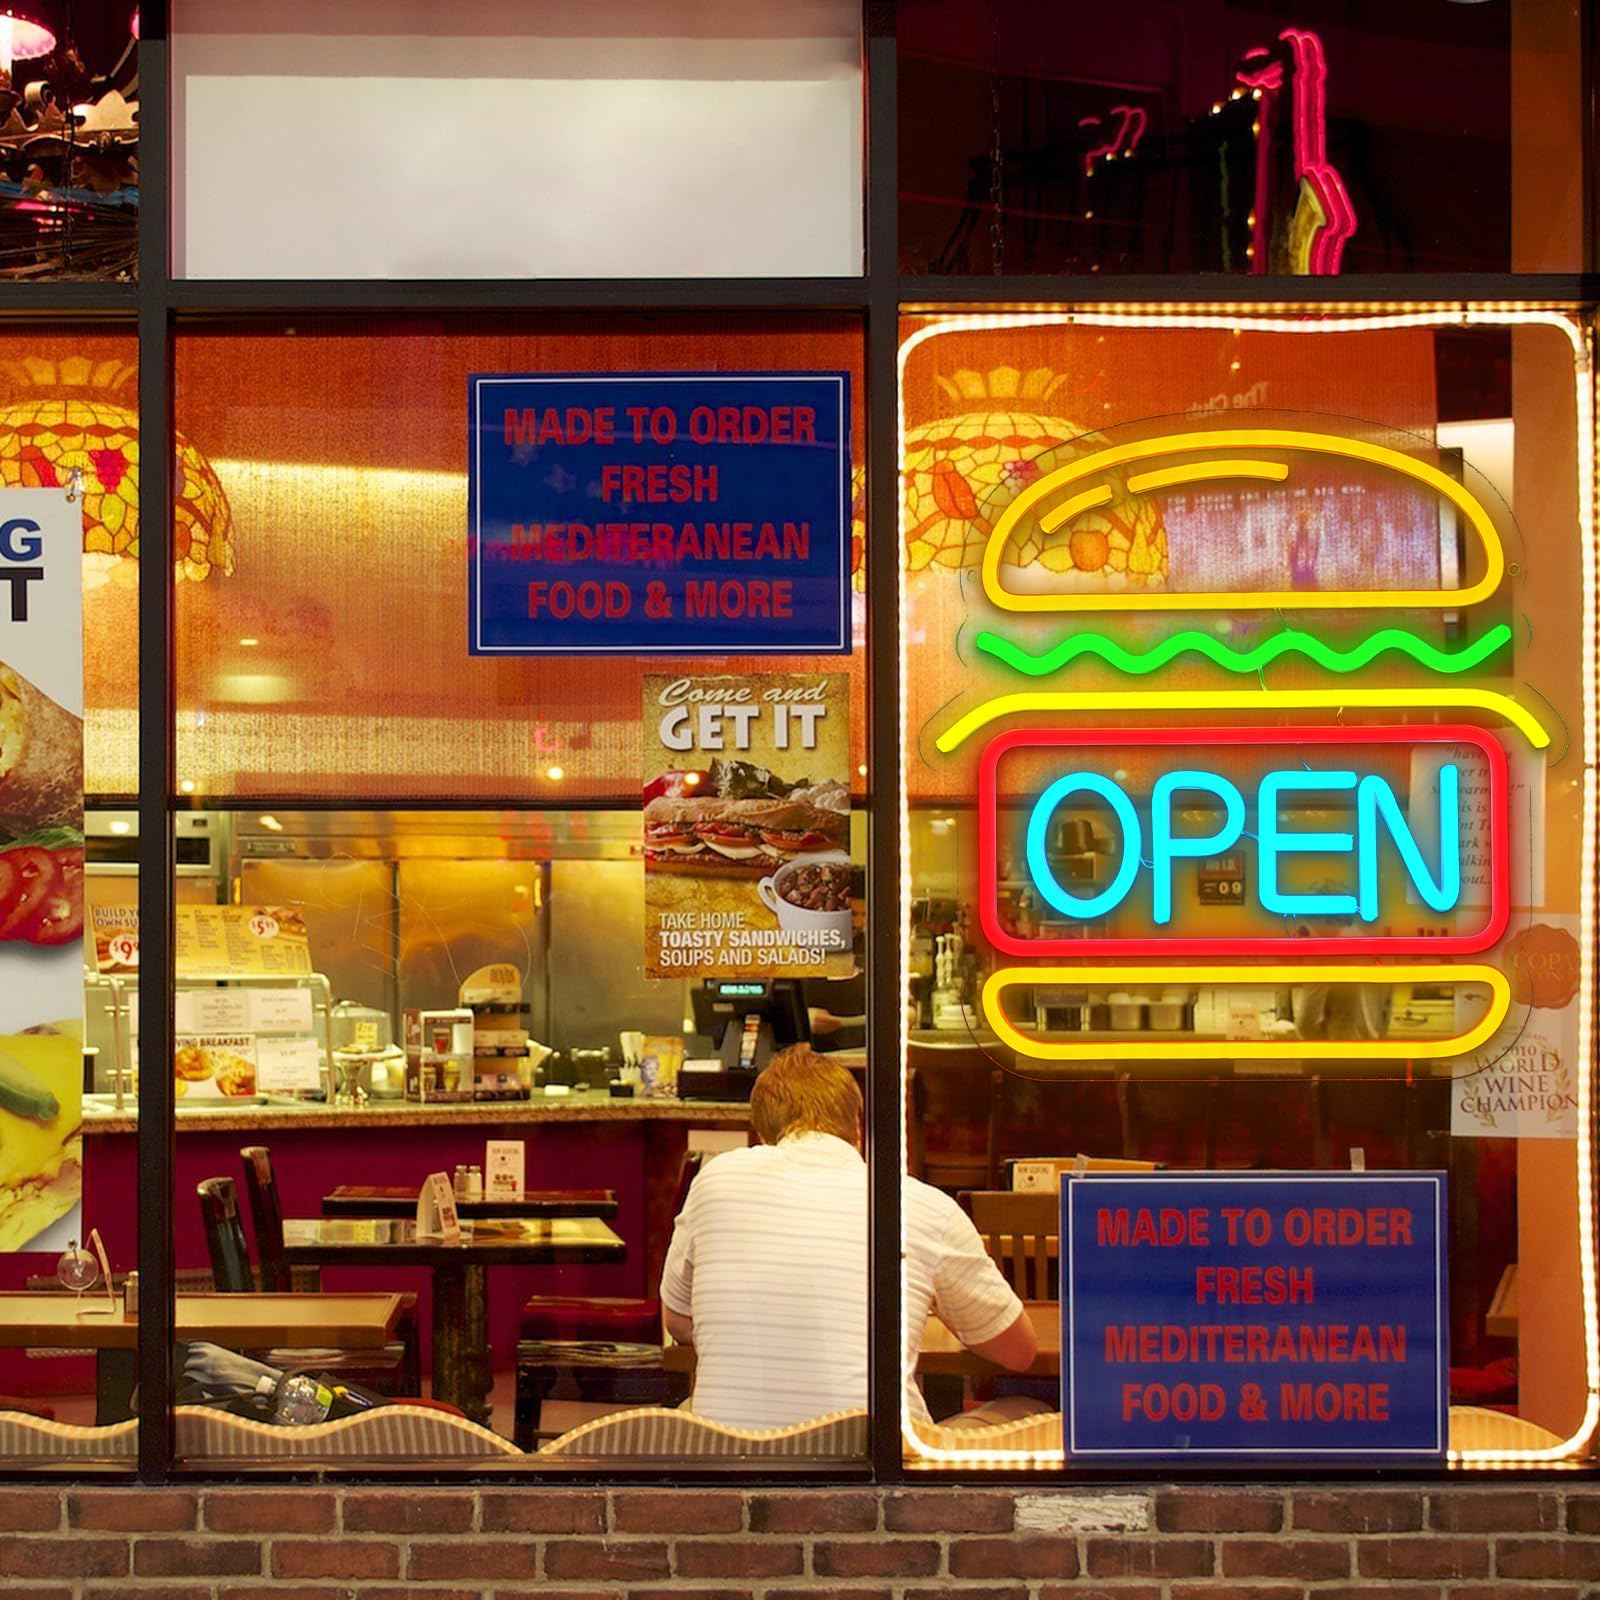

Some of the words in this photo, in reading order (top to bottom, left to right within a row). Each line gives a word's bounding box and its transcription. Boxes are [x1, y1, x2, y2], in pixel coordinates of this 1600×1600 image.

[504, 406, 615, 446] MADE
[626, 406, 677, 445] TO
[689, 406, 816, 446] ORDER
[601, 464, 718, 503] FRESH
[510, 522, 809, 561] MEDITERANEAN
[528, 580, 632, 619] FOOD
[643, 580, 673, 619] &
[685, 580, 793, 619] MORE
[658, 678, 752, 707] Come
[763, 679, 828, 703] and
[659, 704, 759, 751] GET
[775, 704, 826, 749] IT
[1026, 764, 1460, 924] OPEN
[95, 908, 126, 917] BUILD
[96, 918, 122, 927] OWN
[660, 912, 696, 929] TAKE
[701, 912, 745, 928] HOME
[660, 930, 724, 948] TOASTY
[729, 929, 846, 949] SANDWICHES,
[660, 948, 714, 967] SOUPS
[719, 948, 753, 966] AND
[758, 948, 826, 965] SALADS!
[200, 1037, 249, 1047] BREAKFAST
[1502, 1045, 1537, 1057] 2010
[1474, 1051, 1560, 1074] WORLD
[1484, 1074, 1549, 1094] WINE
[1097, 1208, 1209, 1246] MADE
[1220, 1208, 1272, 1246] TO
[1284, 1208, 1413, 1246] ORDER
[1195, 1266, 1314, 1305] FRESH
[1104, 1324, 1407, 1363] MEDITERANEAN
[1122, 1383, 1226, 1422] FOOD
[1238, 1383, 1269, 1422] &
[1280, 1383, 1390, 1422] MORE
